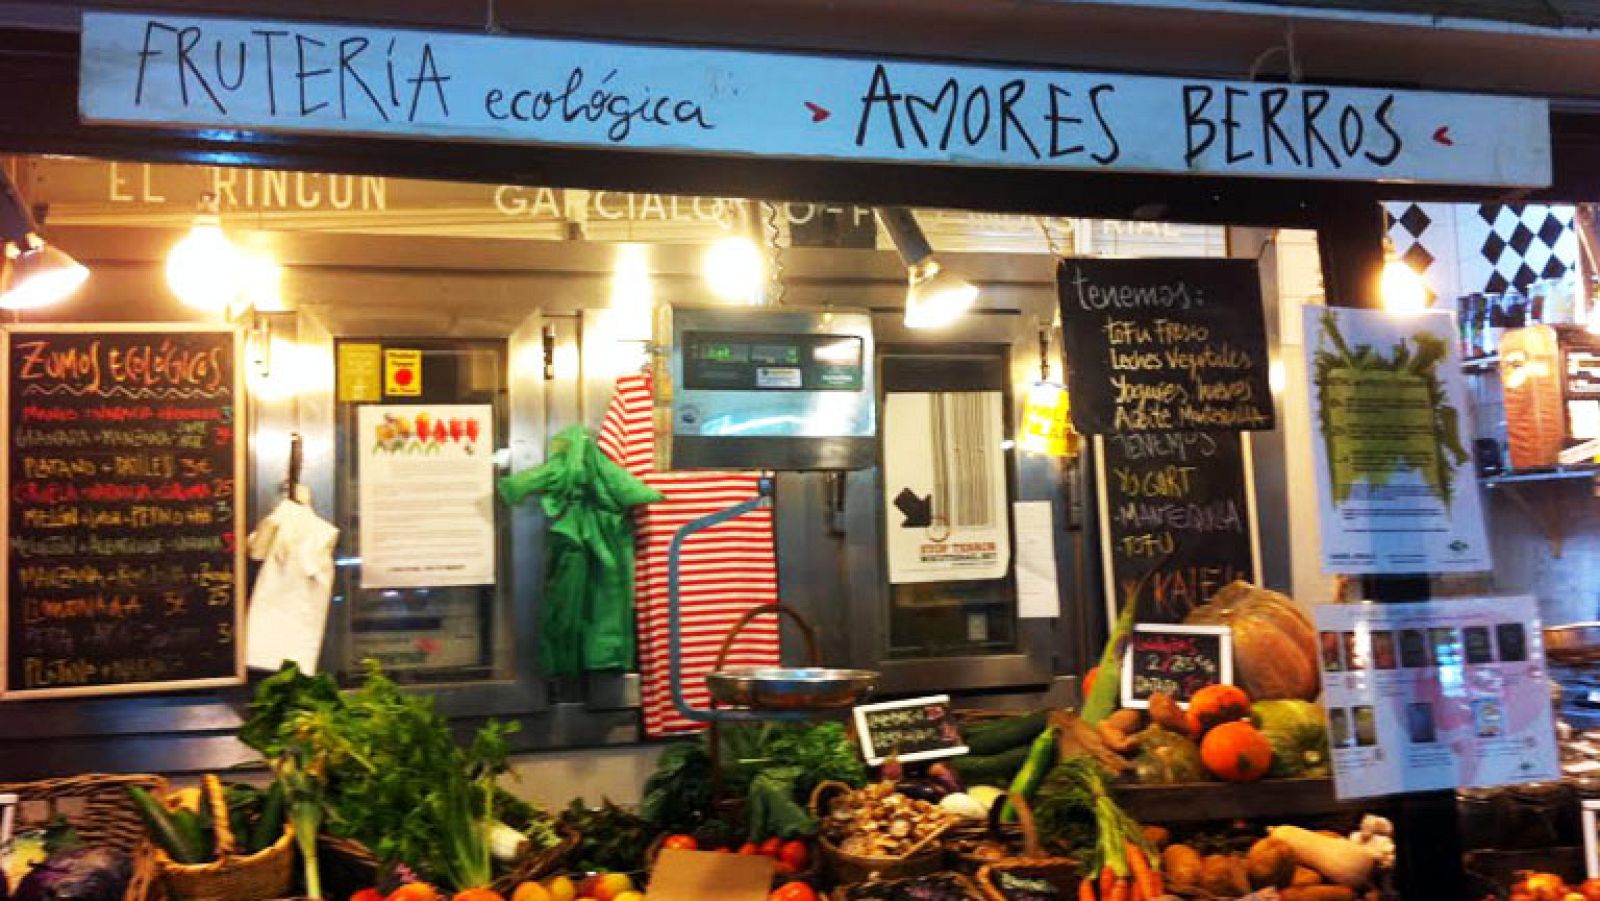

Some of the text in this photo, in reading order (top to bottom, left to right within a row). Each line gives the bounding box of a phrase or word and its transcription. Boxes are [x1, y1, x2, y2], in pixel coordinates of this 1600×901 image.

[485, 66, 717, 143] ecológica
[855, 64, 1404, 168] AMORES BERROS
